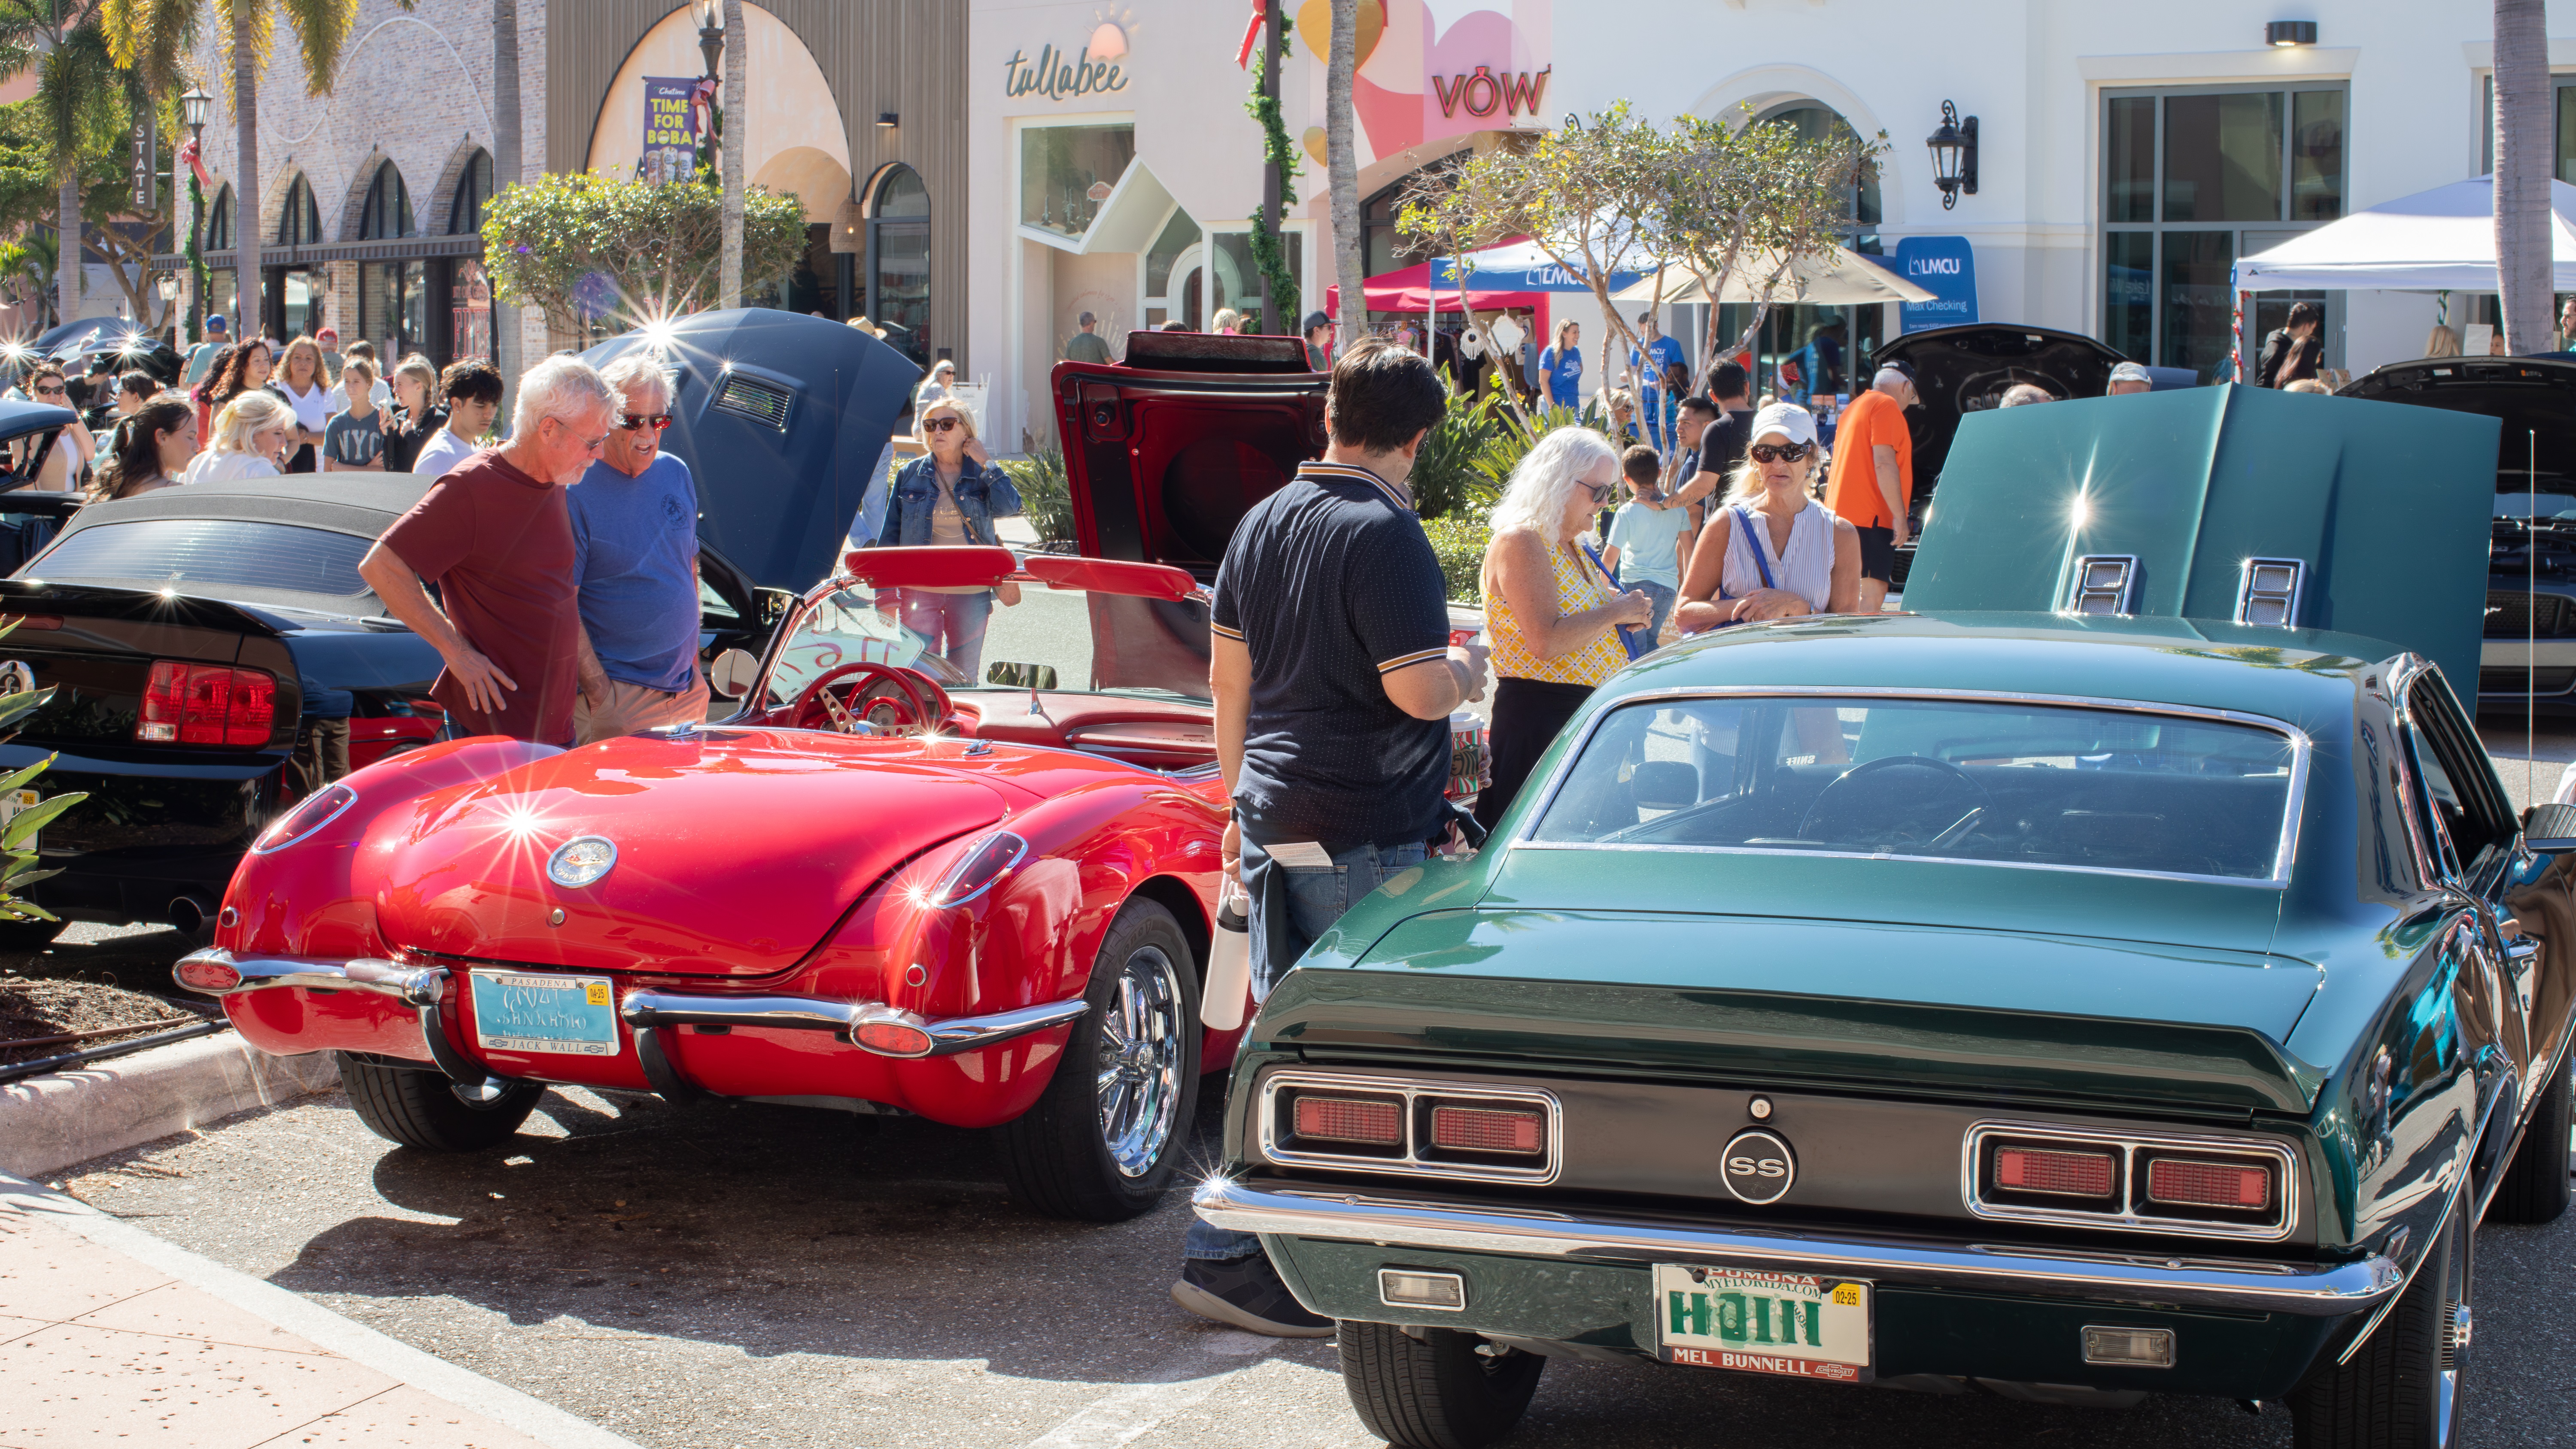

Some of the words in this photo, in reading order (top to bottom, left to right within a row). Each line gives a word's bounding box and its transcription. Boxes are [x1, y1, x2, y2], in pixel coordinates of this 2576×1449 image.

[1005, 43, 1129, 101] tullabee
[659, 87, 686, 95] Chatime
[650, 98, 688, 113] TIME
[654, 114, 684, 128] FOR
[647, 130, 693, 145] BOBA
[1921, 258, 1960, 274] LMCU
[1906, 301, 1924, 311] Max
[1926, 300, 1967, 312] Checking
[337, 429, 380, 460] NYC
[511, 977, 567, 988] PASADENA
[511, 1040, 541, 1050] JACK
[550, 1043, 582, 1052] WALL
[1729, 1157, 1785, 1177] SS
[1708, 1267, 1817, 1285] POMONA
[1835, 1290, 1857, 1306] 02-25
[1674, 1347, 1713, 1364] MEL
[1722, 1353, 1811, 1375] BUNNELL
